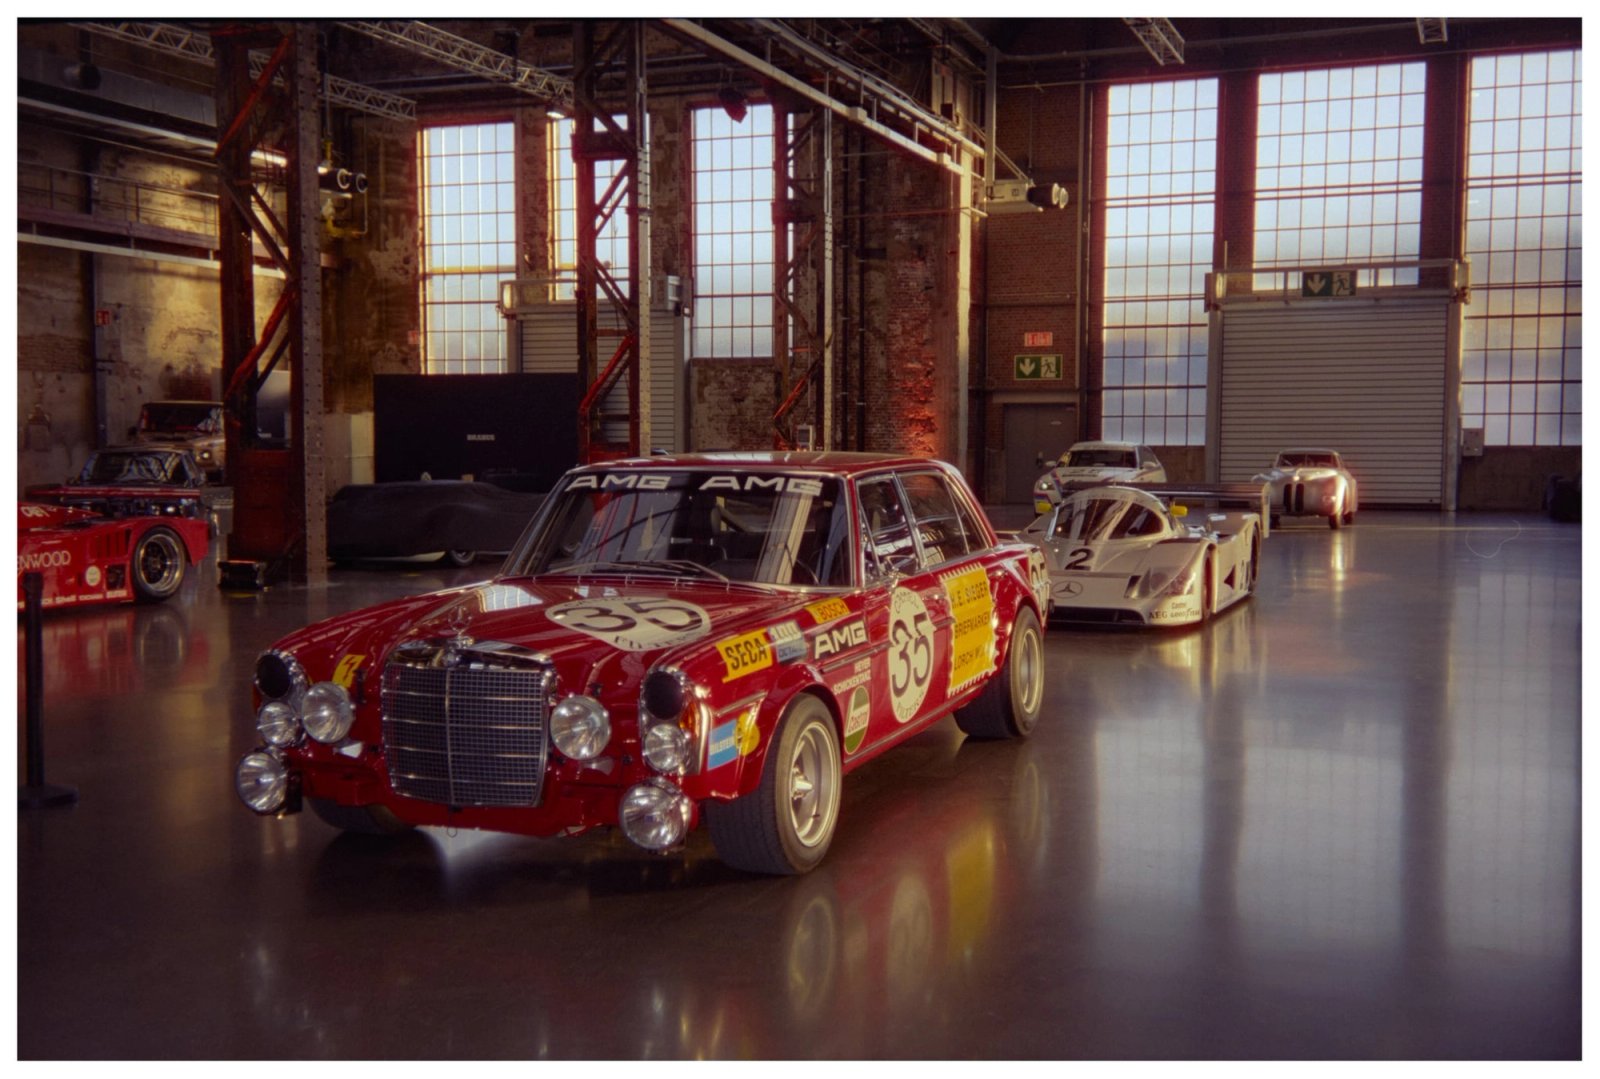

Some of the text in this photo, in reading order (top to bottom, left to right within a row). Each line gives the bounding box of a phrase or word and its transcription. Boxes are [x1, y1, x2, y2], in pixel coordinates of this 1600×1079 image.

[565, 475, 824, 496] AMG AMG
[1065, 548, 1094, 571] 2
[965, 581, 988, 604] SIEGER
[553, 600, 703, 632] 35
[818, 602, 848, 620] BOSCH
[1149, 610, 1168, 619] AEG
[814, 620, 868, 659] AMG
[724, 637, 768, 671] SECA
[891, 611, 931, 698] 35
